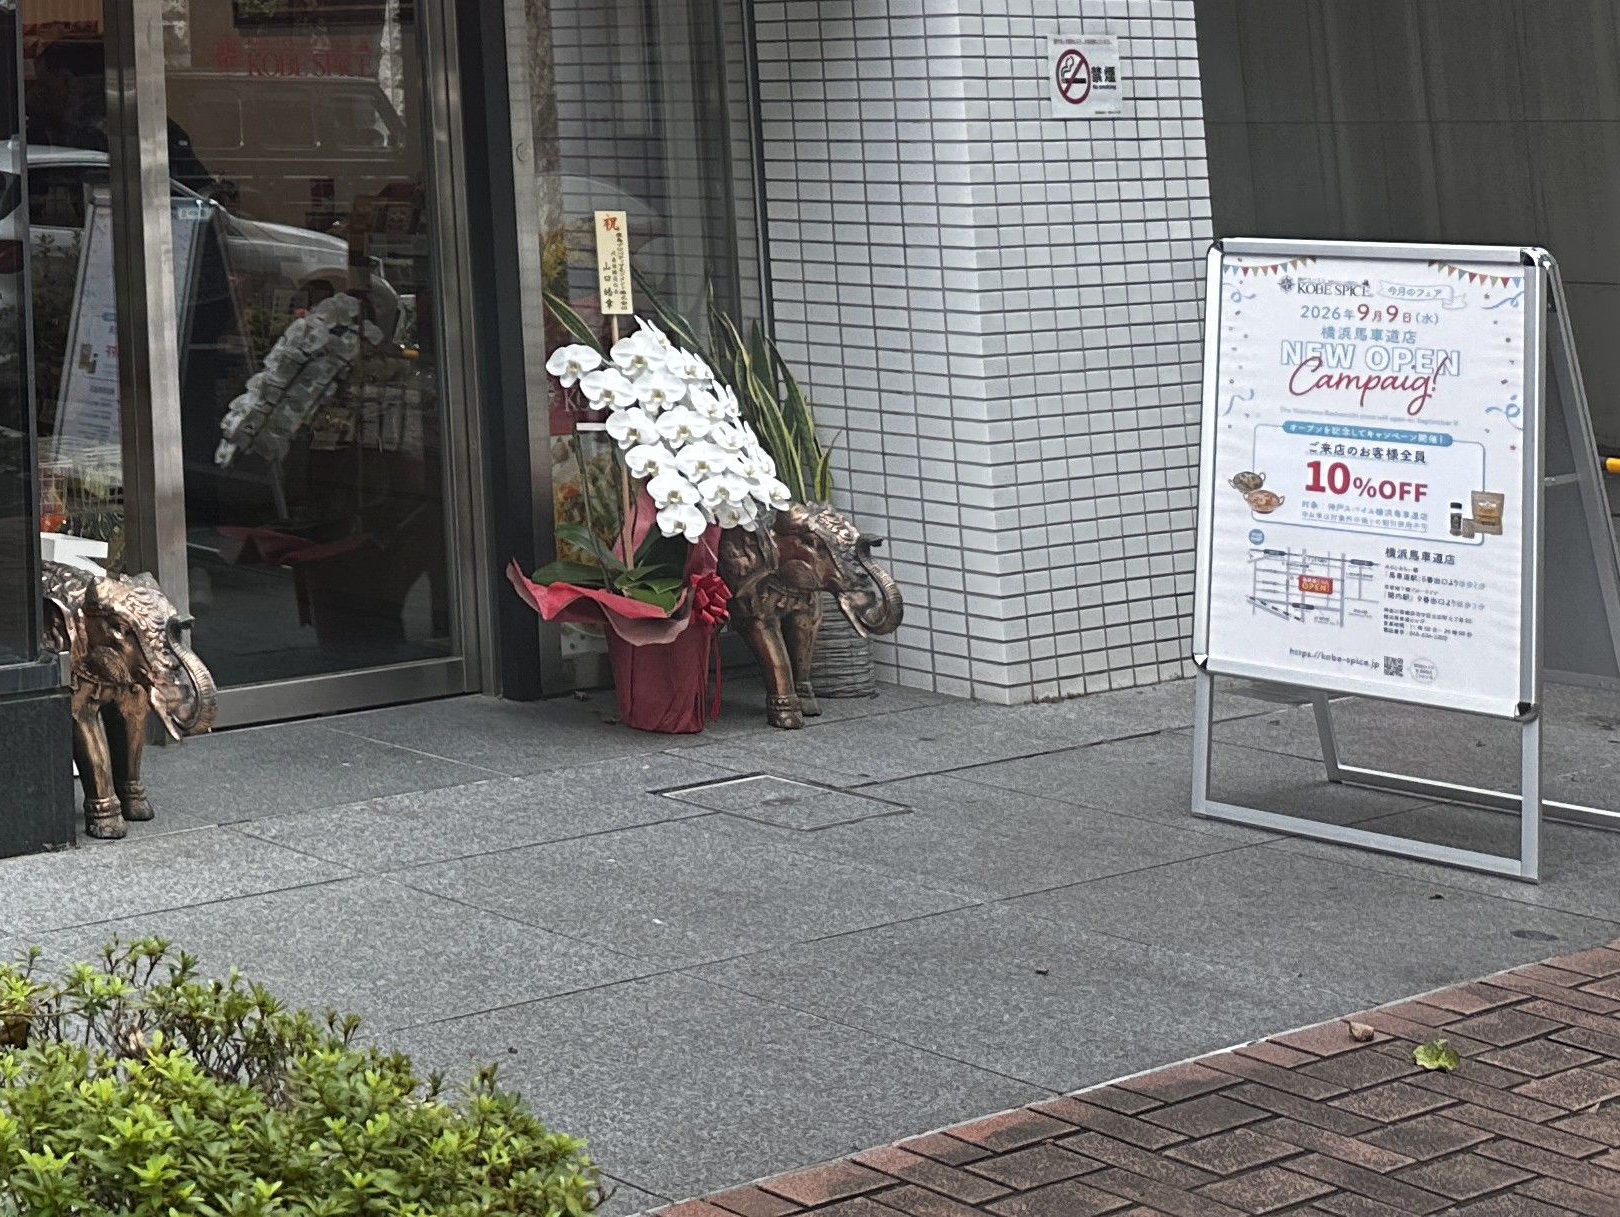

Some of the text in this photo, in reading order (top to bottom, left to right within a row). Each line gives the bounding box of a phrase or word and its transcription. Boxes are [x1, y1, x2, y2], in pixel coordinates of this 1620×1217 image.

[603, 214, 619, 231] 祝
[1297, 283, 1371, 297] KOBE SPICE
[1321, 325, 1417, 344] 横浜馬車道店
[1281, 340, 1461, 376] NEW OPEN
[1309, 441, 1426, 464] ご来店のお客様全員
